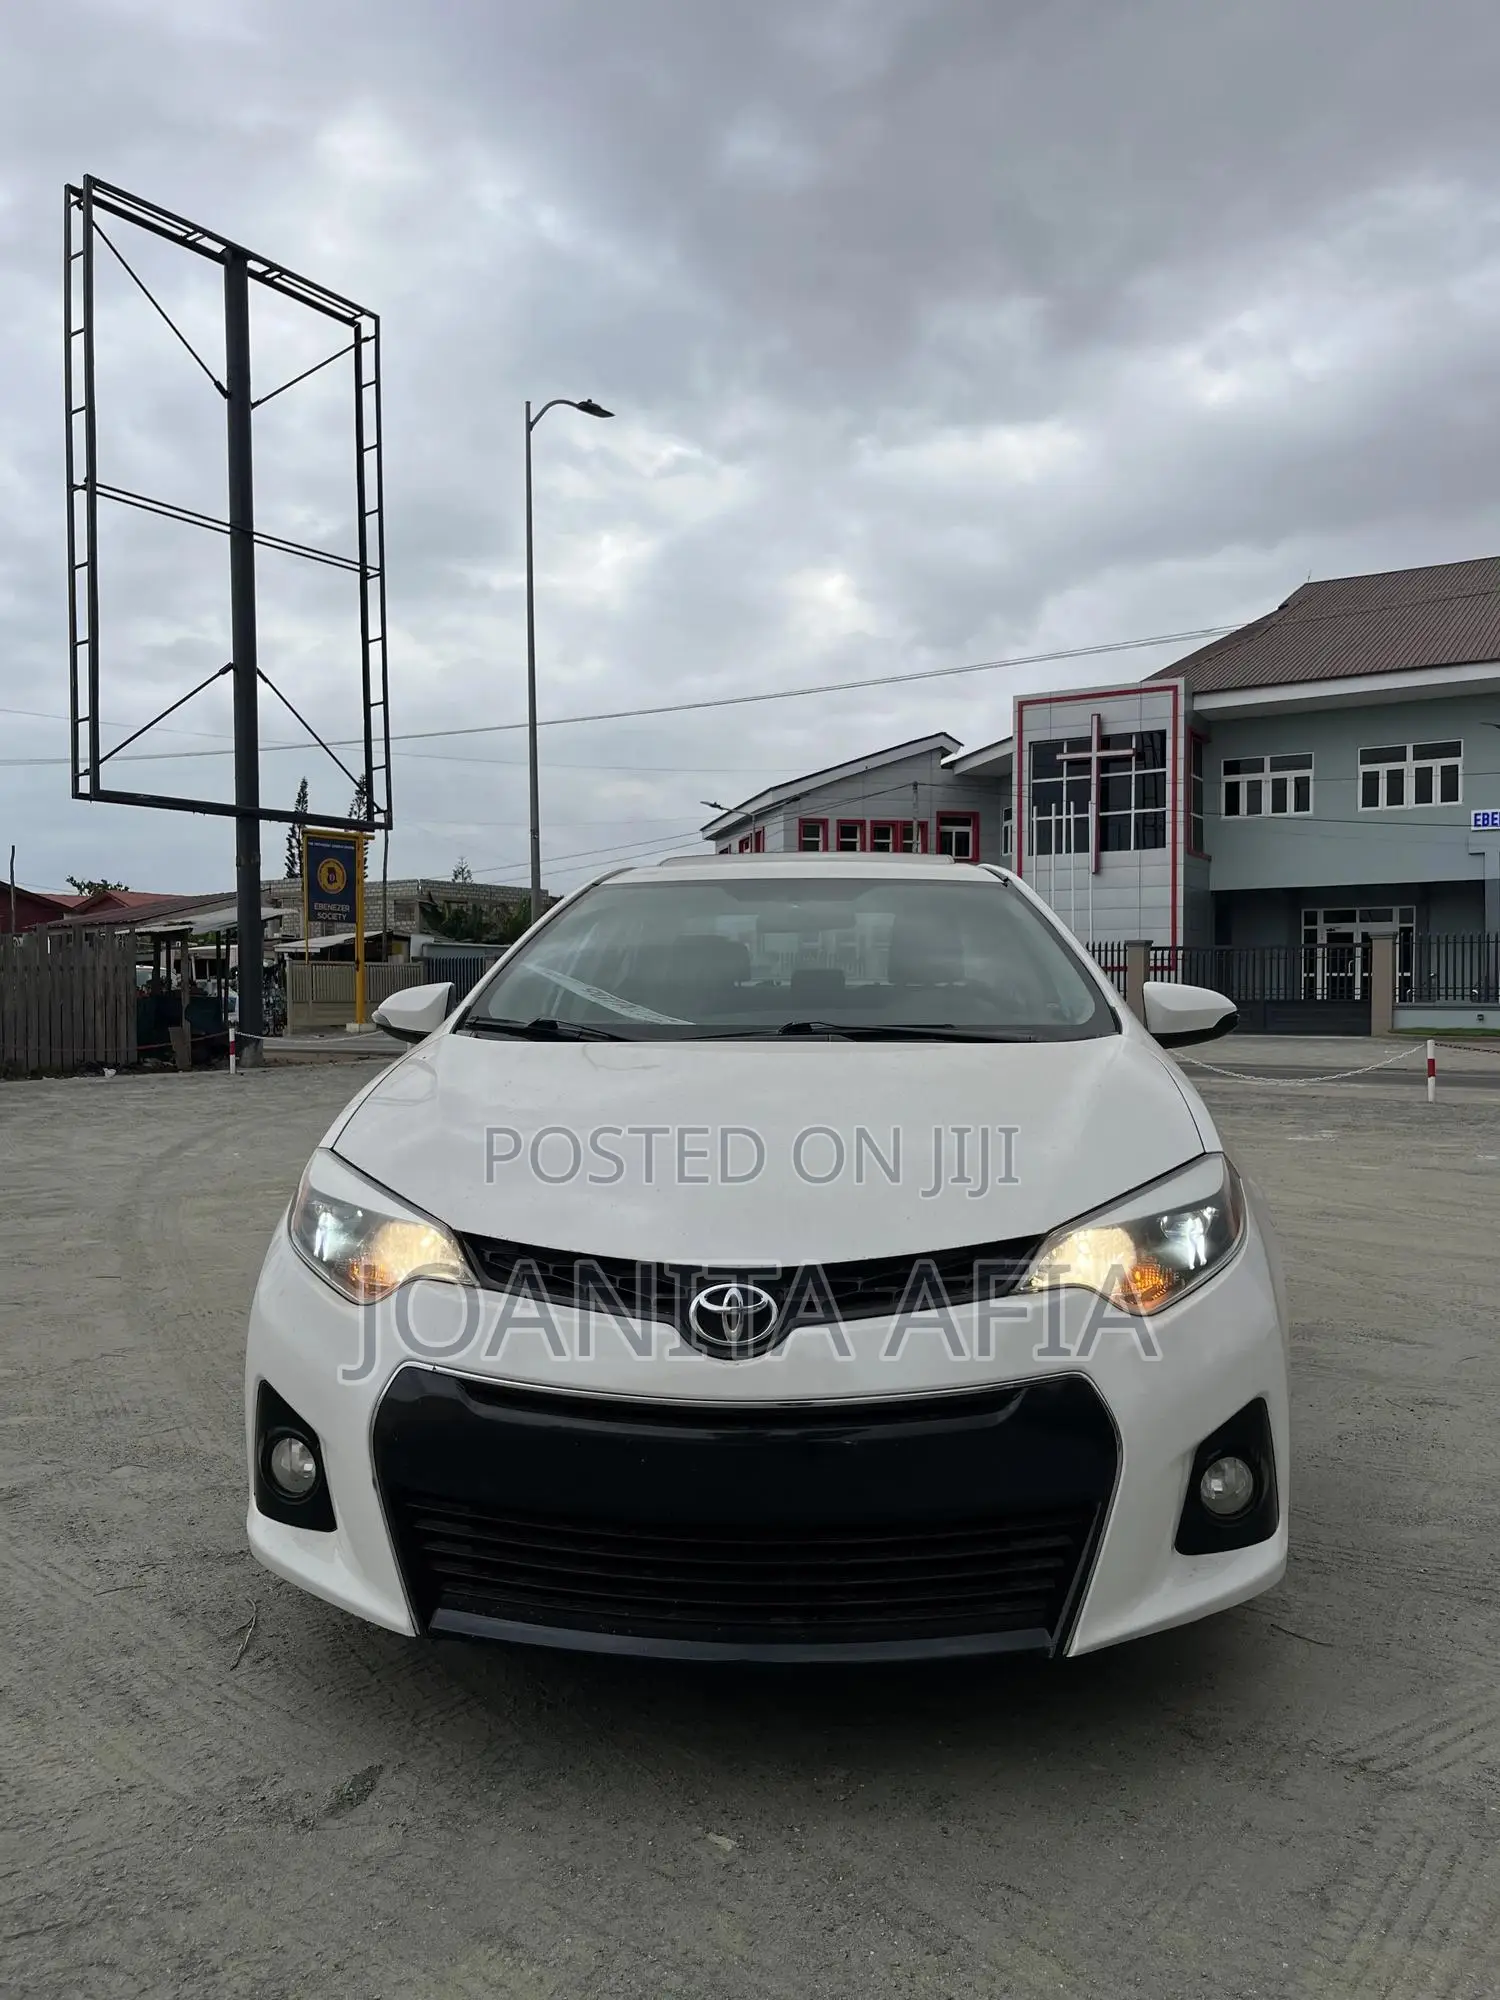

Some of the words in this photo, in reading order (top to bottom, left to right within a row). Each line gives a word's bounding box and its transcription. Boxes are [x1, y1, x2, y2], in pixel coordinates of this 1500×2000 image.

[1474, 812, 1500, 827] EBE
[313, 902, 350, 912] EBENEZER
[316, 911, 347, 921] SOCIETY
